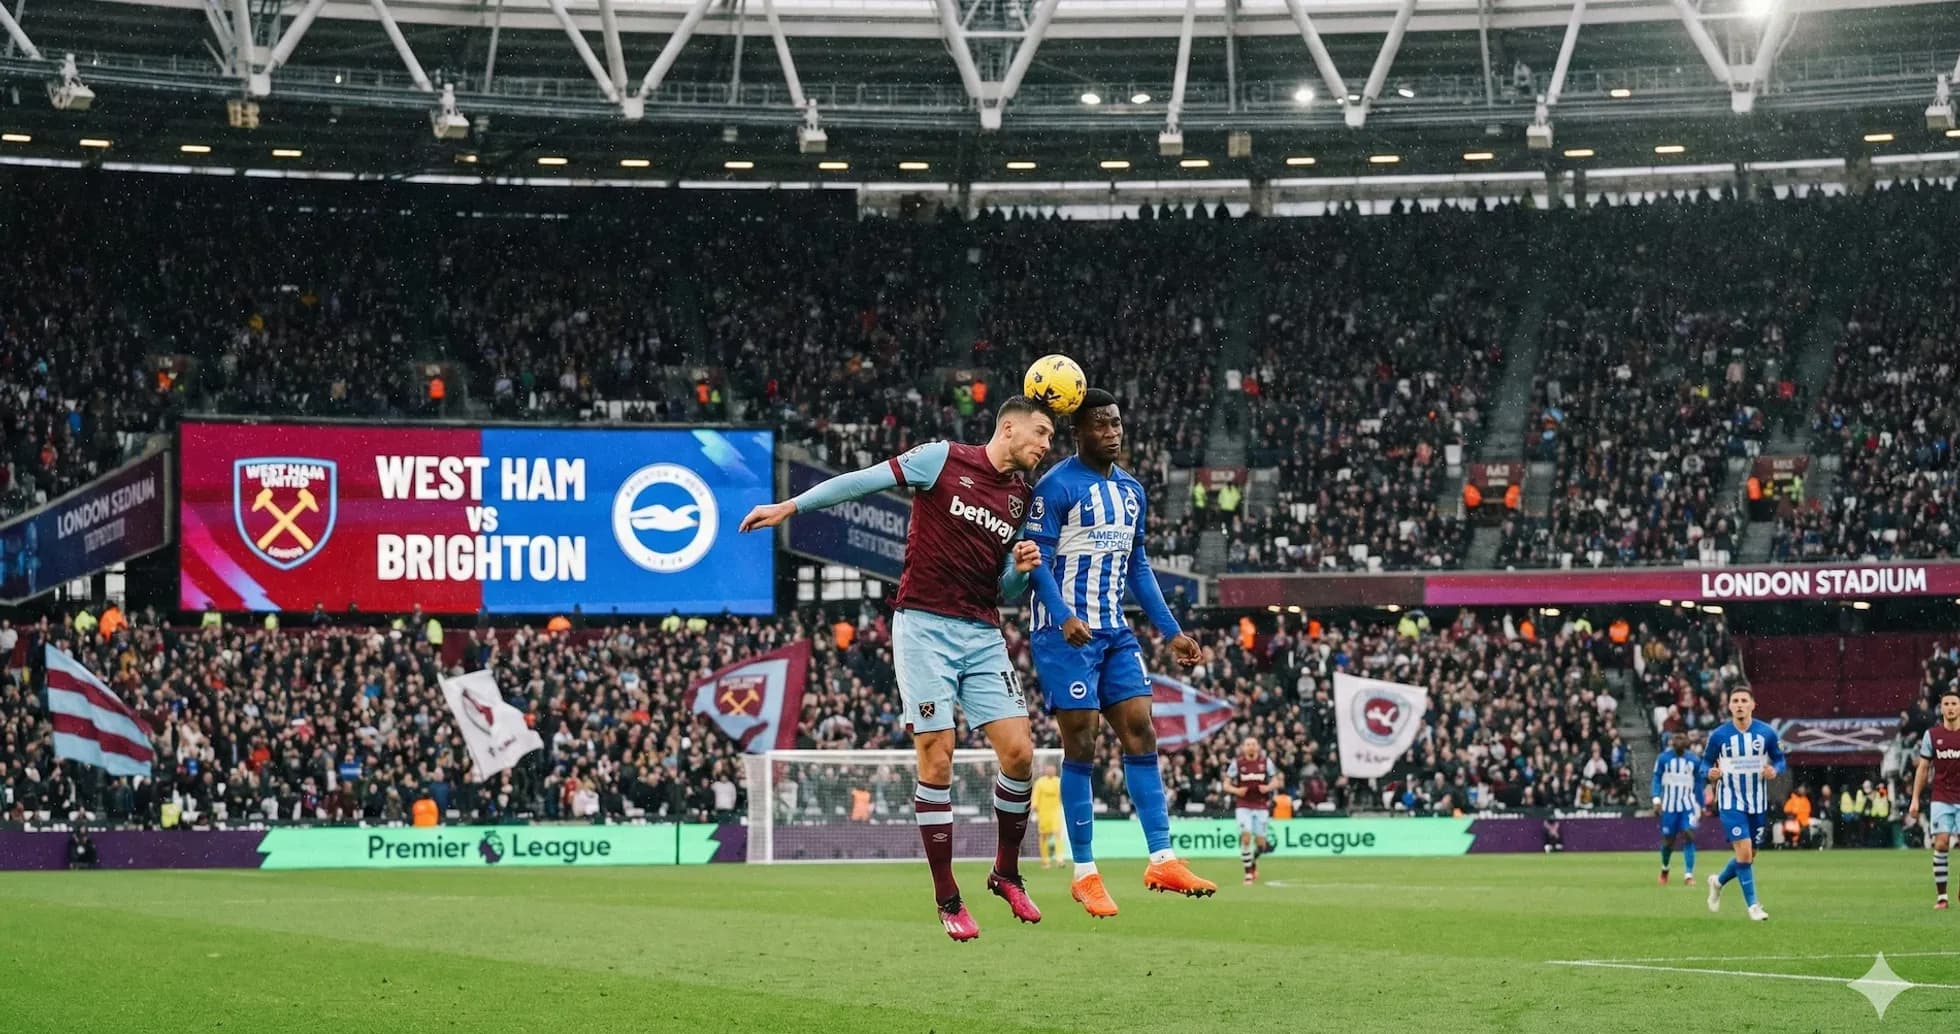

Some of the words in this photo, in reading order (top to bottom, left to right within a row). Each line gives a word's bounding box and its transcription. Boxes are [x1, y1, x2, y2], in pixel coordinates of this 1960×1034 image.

[375, 455, 490, 501] WEST
[501, 456, 586, 501] HAM
[57, 494, 110, 539] LONDON
[949, 495, 1017, 545] betway
[376, 533, 587, 582] BRIGHTON
[1701, 571, 1810, 598] LONDON
[1815, 567, 1928, 595] STADIUM
[368, 834, 471, 859] Premier
[512, 833, 611, 863] League
[1284, 826, 1376, 854] League
